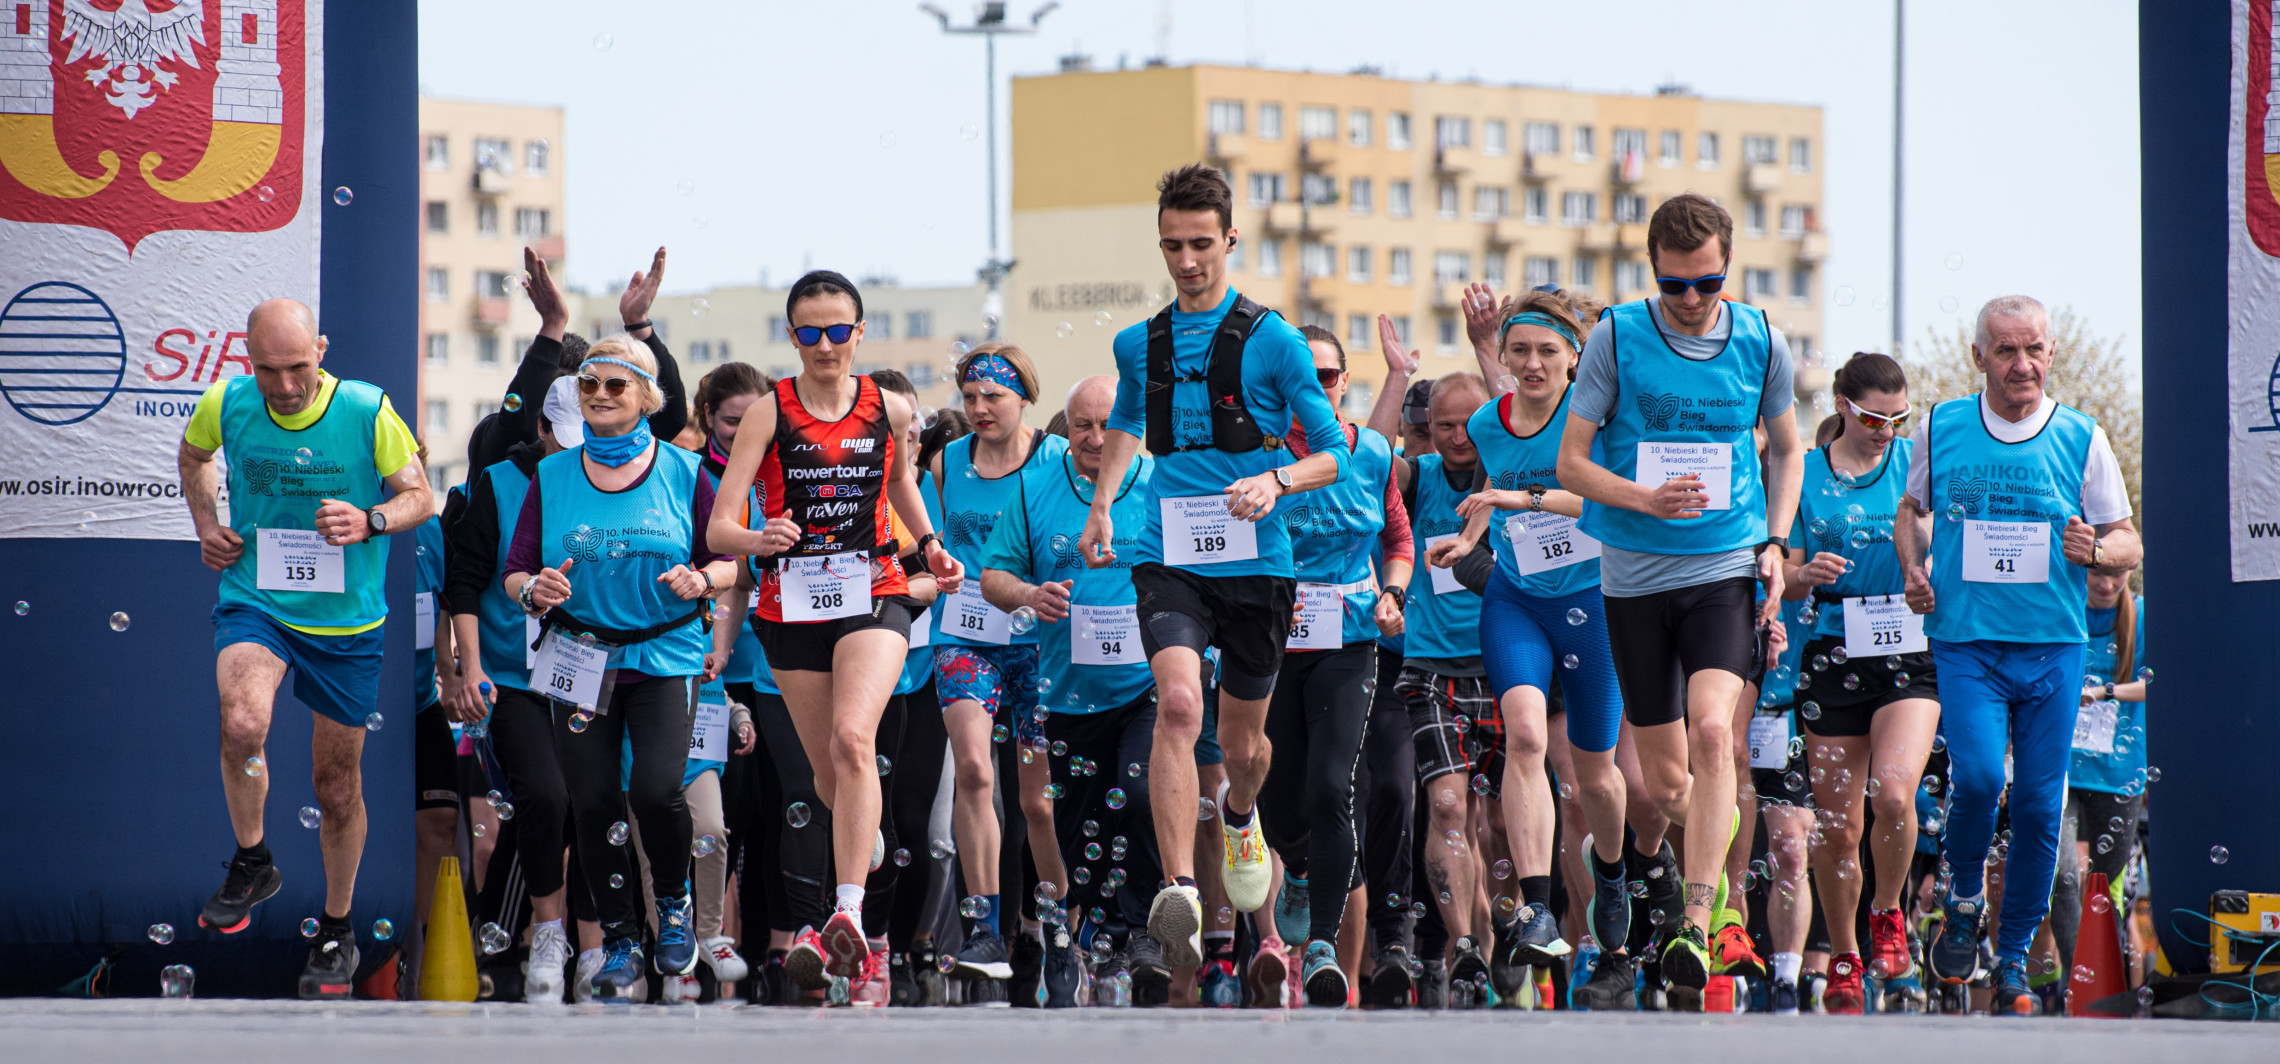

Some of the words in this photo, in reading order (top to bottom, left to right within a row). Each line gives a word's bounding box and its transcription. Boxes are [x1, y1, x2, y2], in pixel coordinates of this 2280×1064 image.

[1681, 398, 1694, 408] 10.
[1698, 396, 1746, 408] Niebieski
[1182, 408, 1196, 417] 10.
[1680, 410, 1706, 421] Bieg
[1183, 421, 1206, 432] Bieg
[1678, 422, 1748, 432] Świadomości
[1651, 446, 1662, 454] 10.
[1664, 446, 1698, 454] Niebieski
[1702, 447, 1718, 456] Bieg
[1660, 455, 1708, 464] Świadomości
[279, 465, 292, 474] 10.
[295, 464, 345, 475] Niebieski
[281, 476, 304, 487] Bieg
[281, 486, 350, 498] Świadomości
[1989, 482, 2003, 492] 10.
[2006, 483, 2055, 498] Niebieski
[1174, 501, 1185, 509] 10.
[1186, 500, 1219, 509] Niebieski
[1988, 493, 2013, 505] Bieg
[1310, 506, 1323, 516] 10.
[1988, 504, 2059, 520] Świadomości
[1312, 518, 1334, 528] Bieg
[1988, 524, 2018, 532] Niebieski
[2022, 525, 2038, 533] Bieg
[605, 529, 619, 538] 10.
[622, 527, 671, 538] Niebieski
[1852, 525, 1874, 535] Bieg
[269, 532, 280, 540] 10.
[282, 532, 312, 541] Niebieski
[316, 533, 326, 542] Bie
[1984, 532, 2028, 541] Świadomości
[278, 541, 322, 550] Świadomości
[1193, 536, 1226, 553] 189
[1542, 540, 1574, 560] 182
[791, 560, 802, 568] 10.
[840, 556, 855, 564] Bieg
[1994, 558, 2016, 573] 41
[286, 566, 316, 581] 153
[1316, 590, 1331, 599] Bieg
[811, 593, 844, 610] 208
[1081, 608, 1091, 616] 10.
[1092, 608, 1122, 616] Niebieski
[1864, 606, 1907, 615] Świadomości
[960, 614, 984, 631] 181
[1090, 616, 1132, 625] Świadomości
[1873, 630, 1903, 646] 215
[1101, 641, 1122, 655] 94
[581, 648, 595, 660] Bieg
[550, 672, 574, 693] 103
[690, 737, 704, 750] 94
